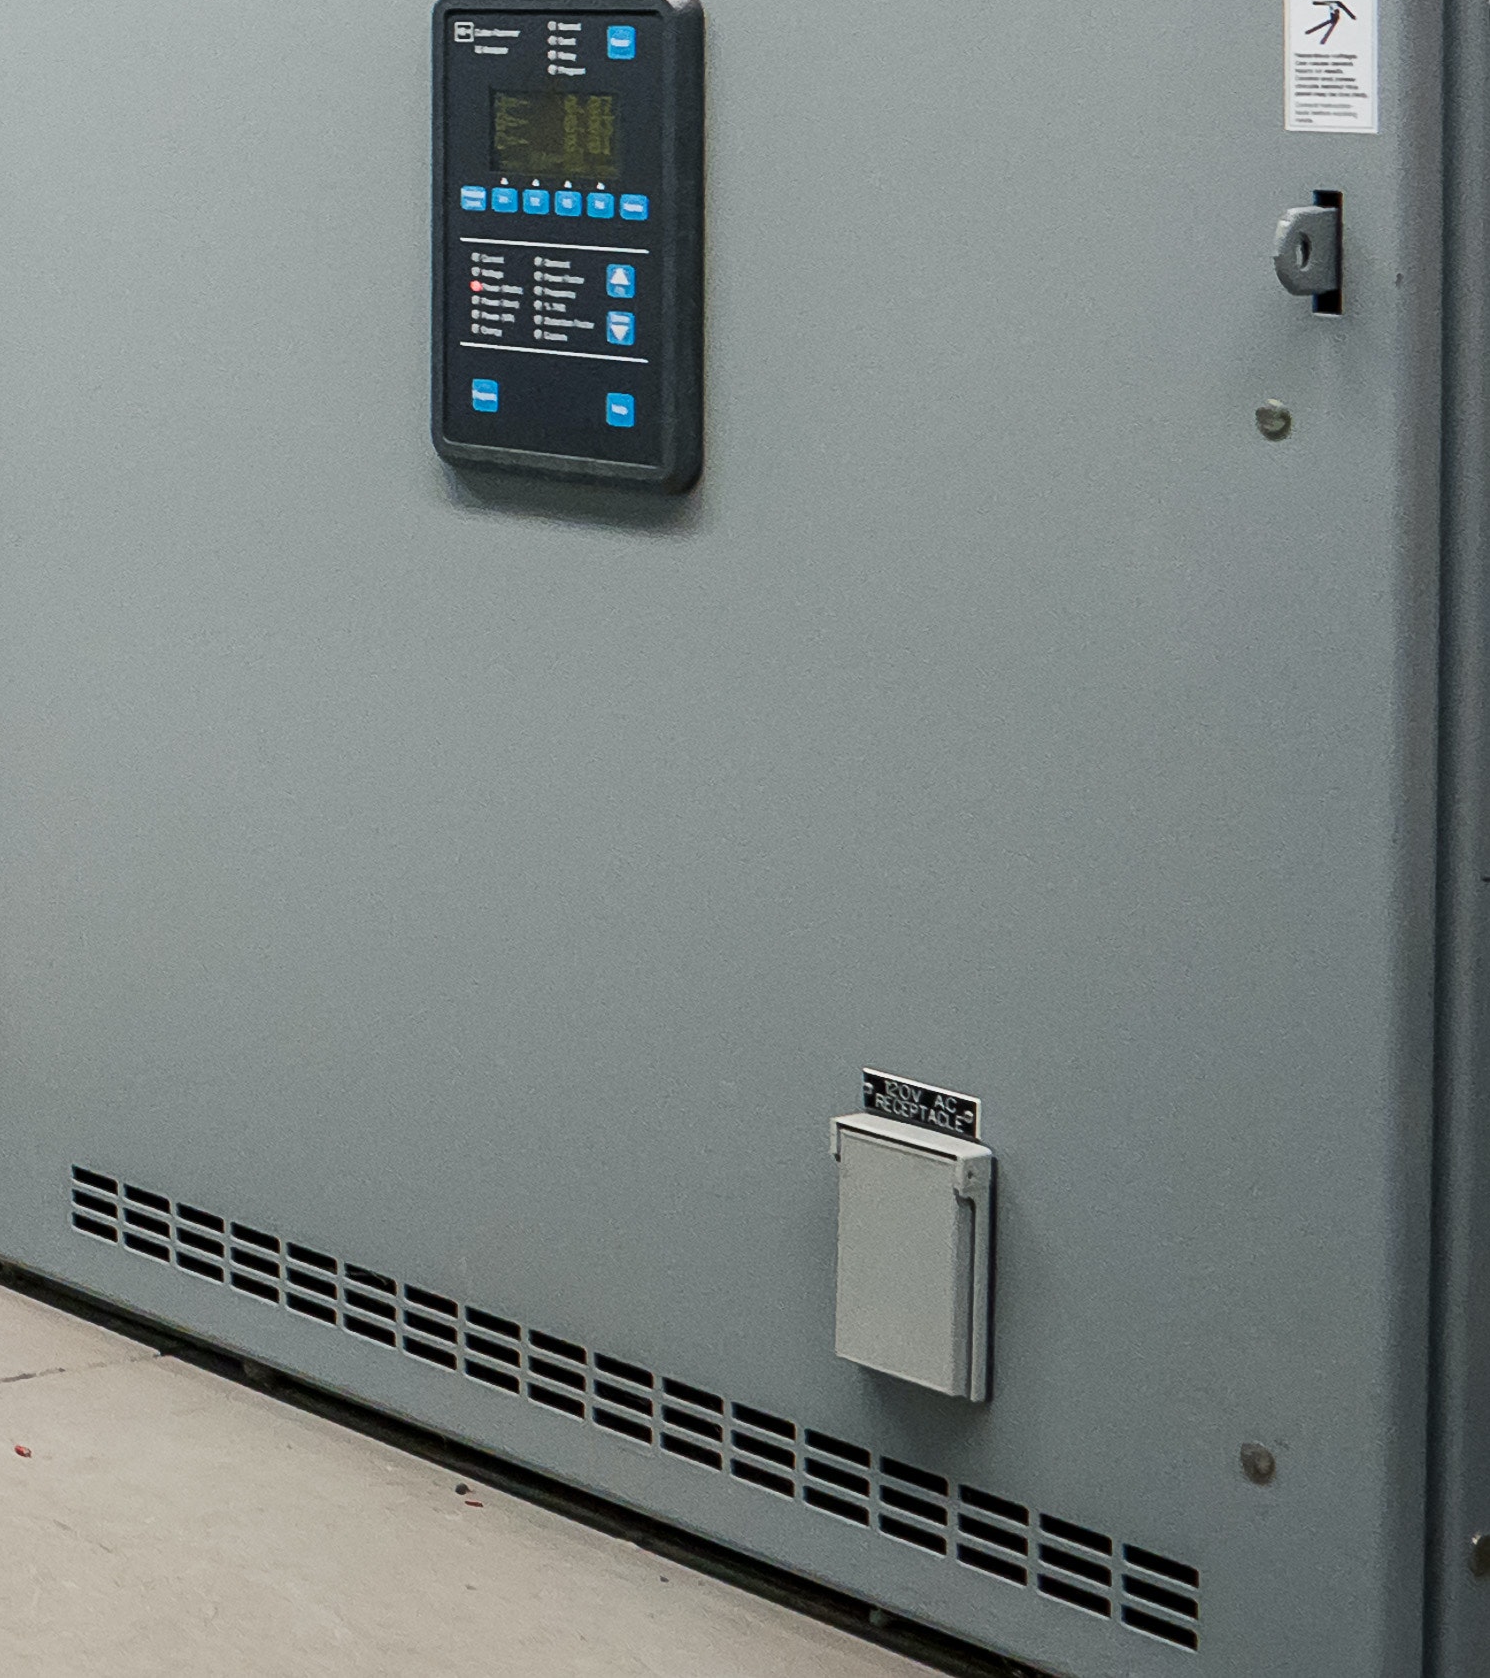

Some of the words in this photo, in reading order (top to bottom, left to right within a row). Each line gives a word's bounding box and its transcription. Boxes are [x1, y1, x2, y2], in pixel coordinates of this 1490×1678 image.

[875, 1092, 964, 1134] RECEPTACLE
[884, 1080, 923, 1103] 120V
[934, 1094, 958, 1114] AC
